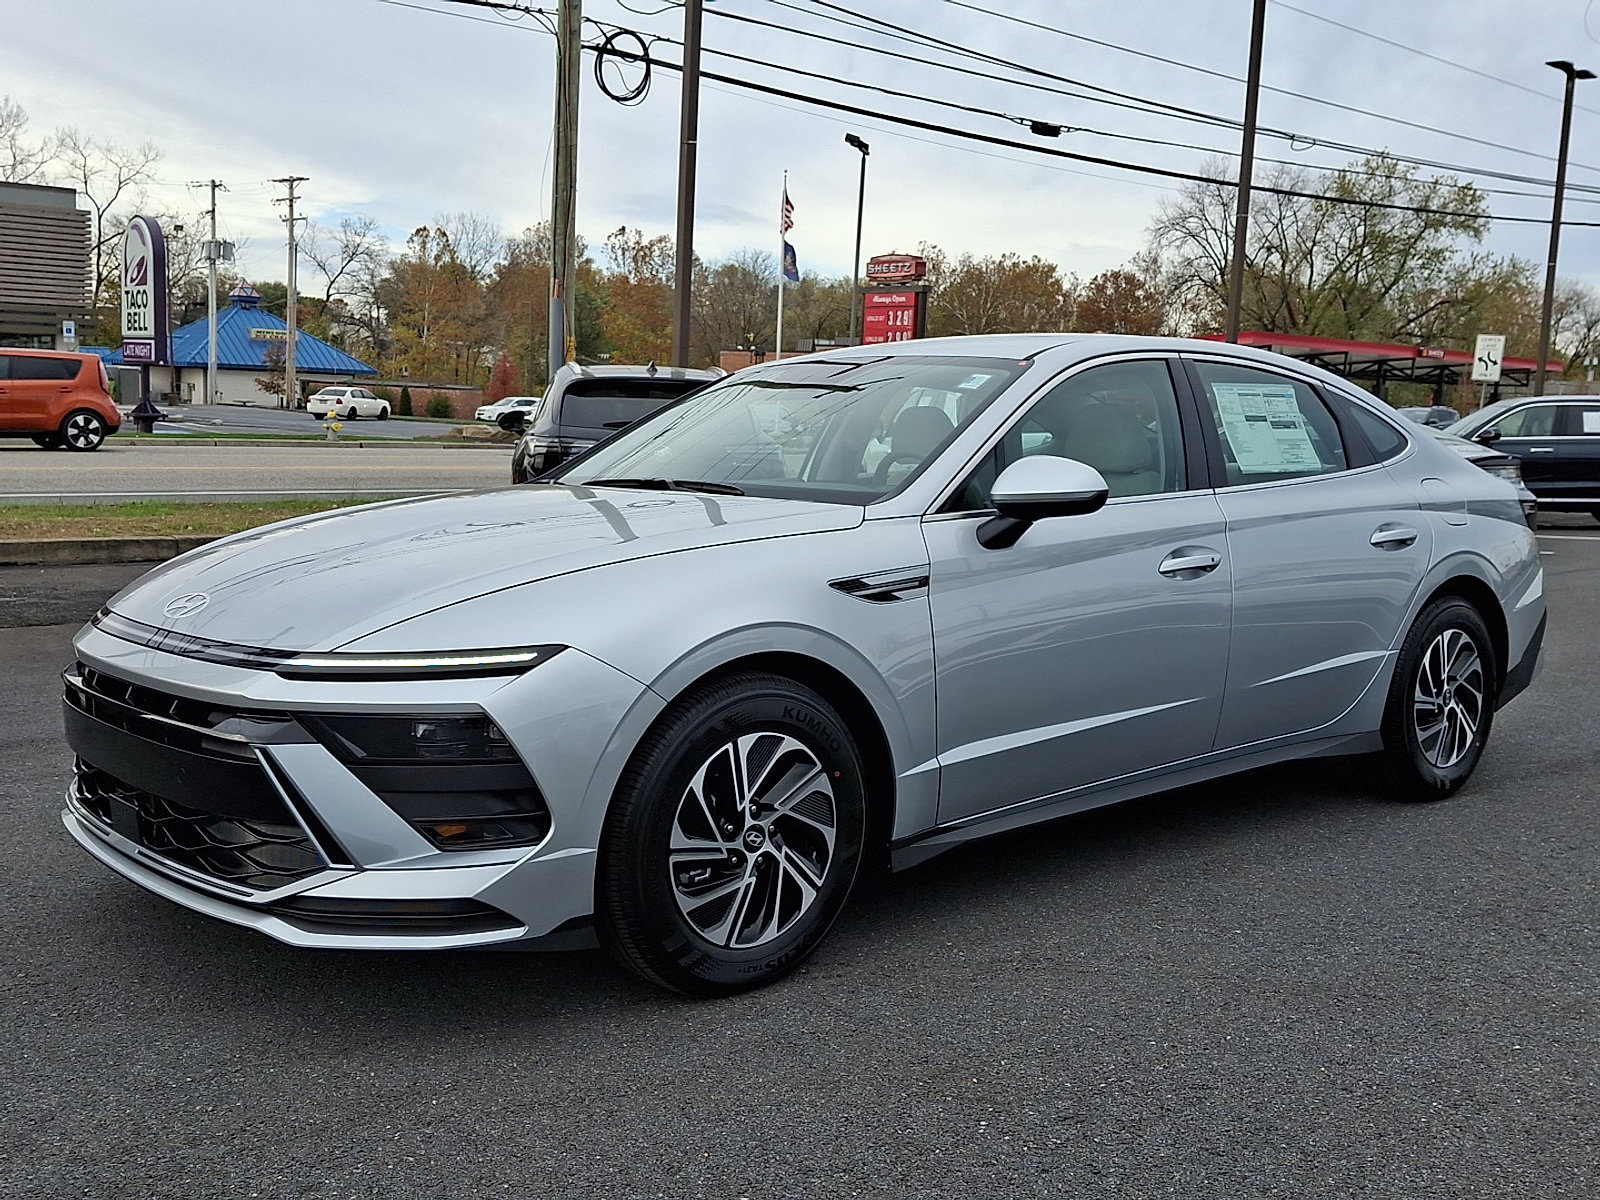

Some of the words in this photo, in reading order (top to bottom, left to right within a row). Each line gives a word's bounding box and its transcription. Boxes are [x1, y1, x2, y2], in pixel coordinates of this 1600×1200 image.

[868, 262, 912, 274] SHEETZ
[125, 289, 148, 310] TACO
[873, 296, 892, 304] Always
[892, 295, 906, 303] Open
[127, 312, 148, 331] BELL
[887, 310, 909, 326] 3.29
[887, 331, 908, 343] 299
[124, 344, 135, 355] LATE
[135, 345, 151, 357] NIGHT
[782, 706, 841, 752] KUMHO
